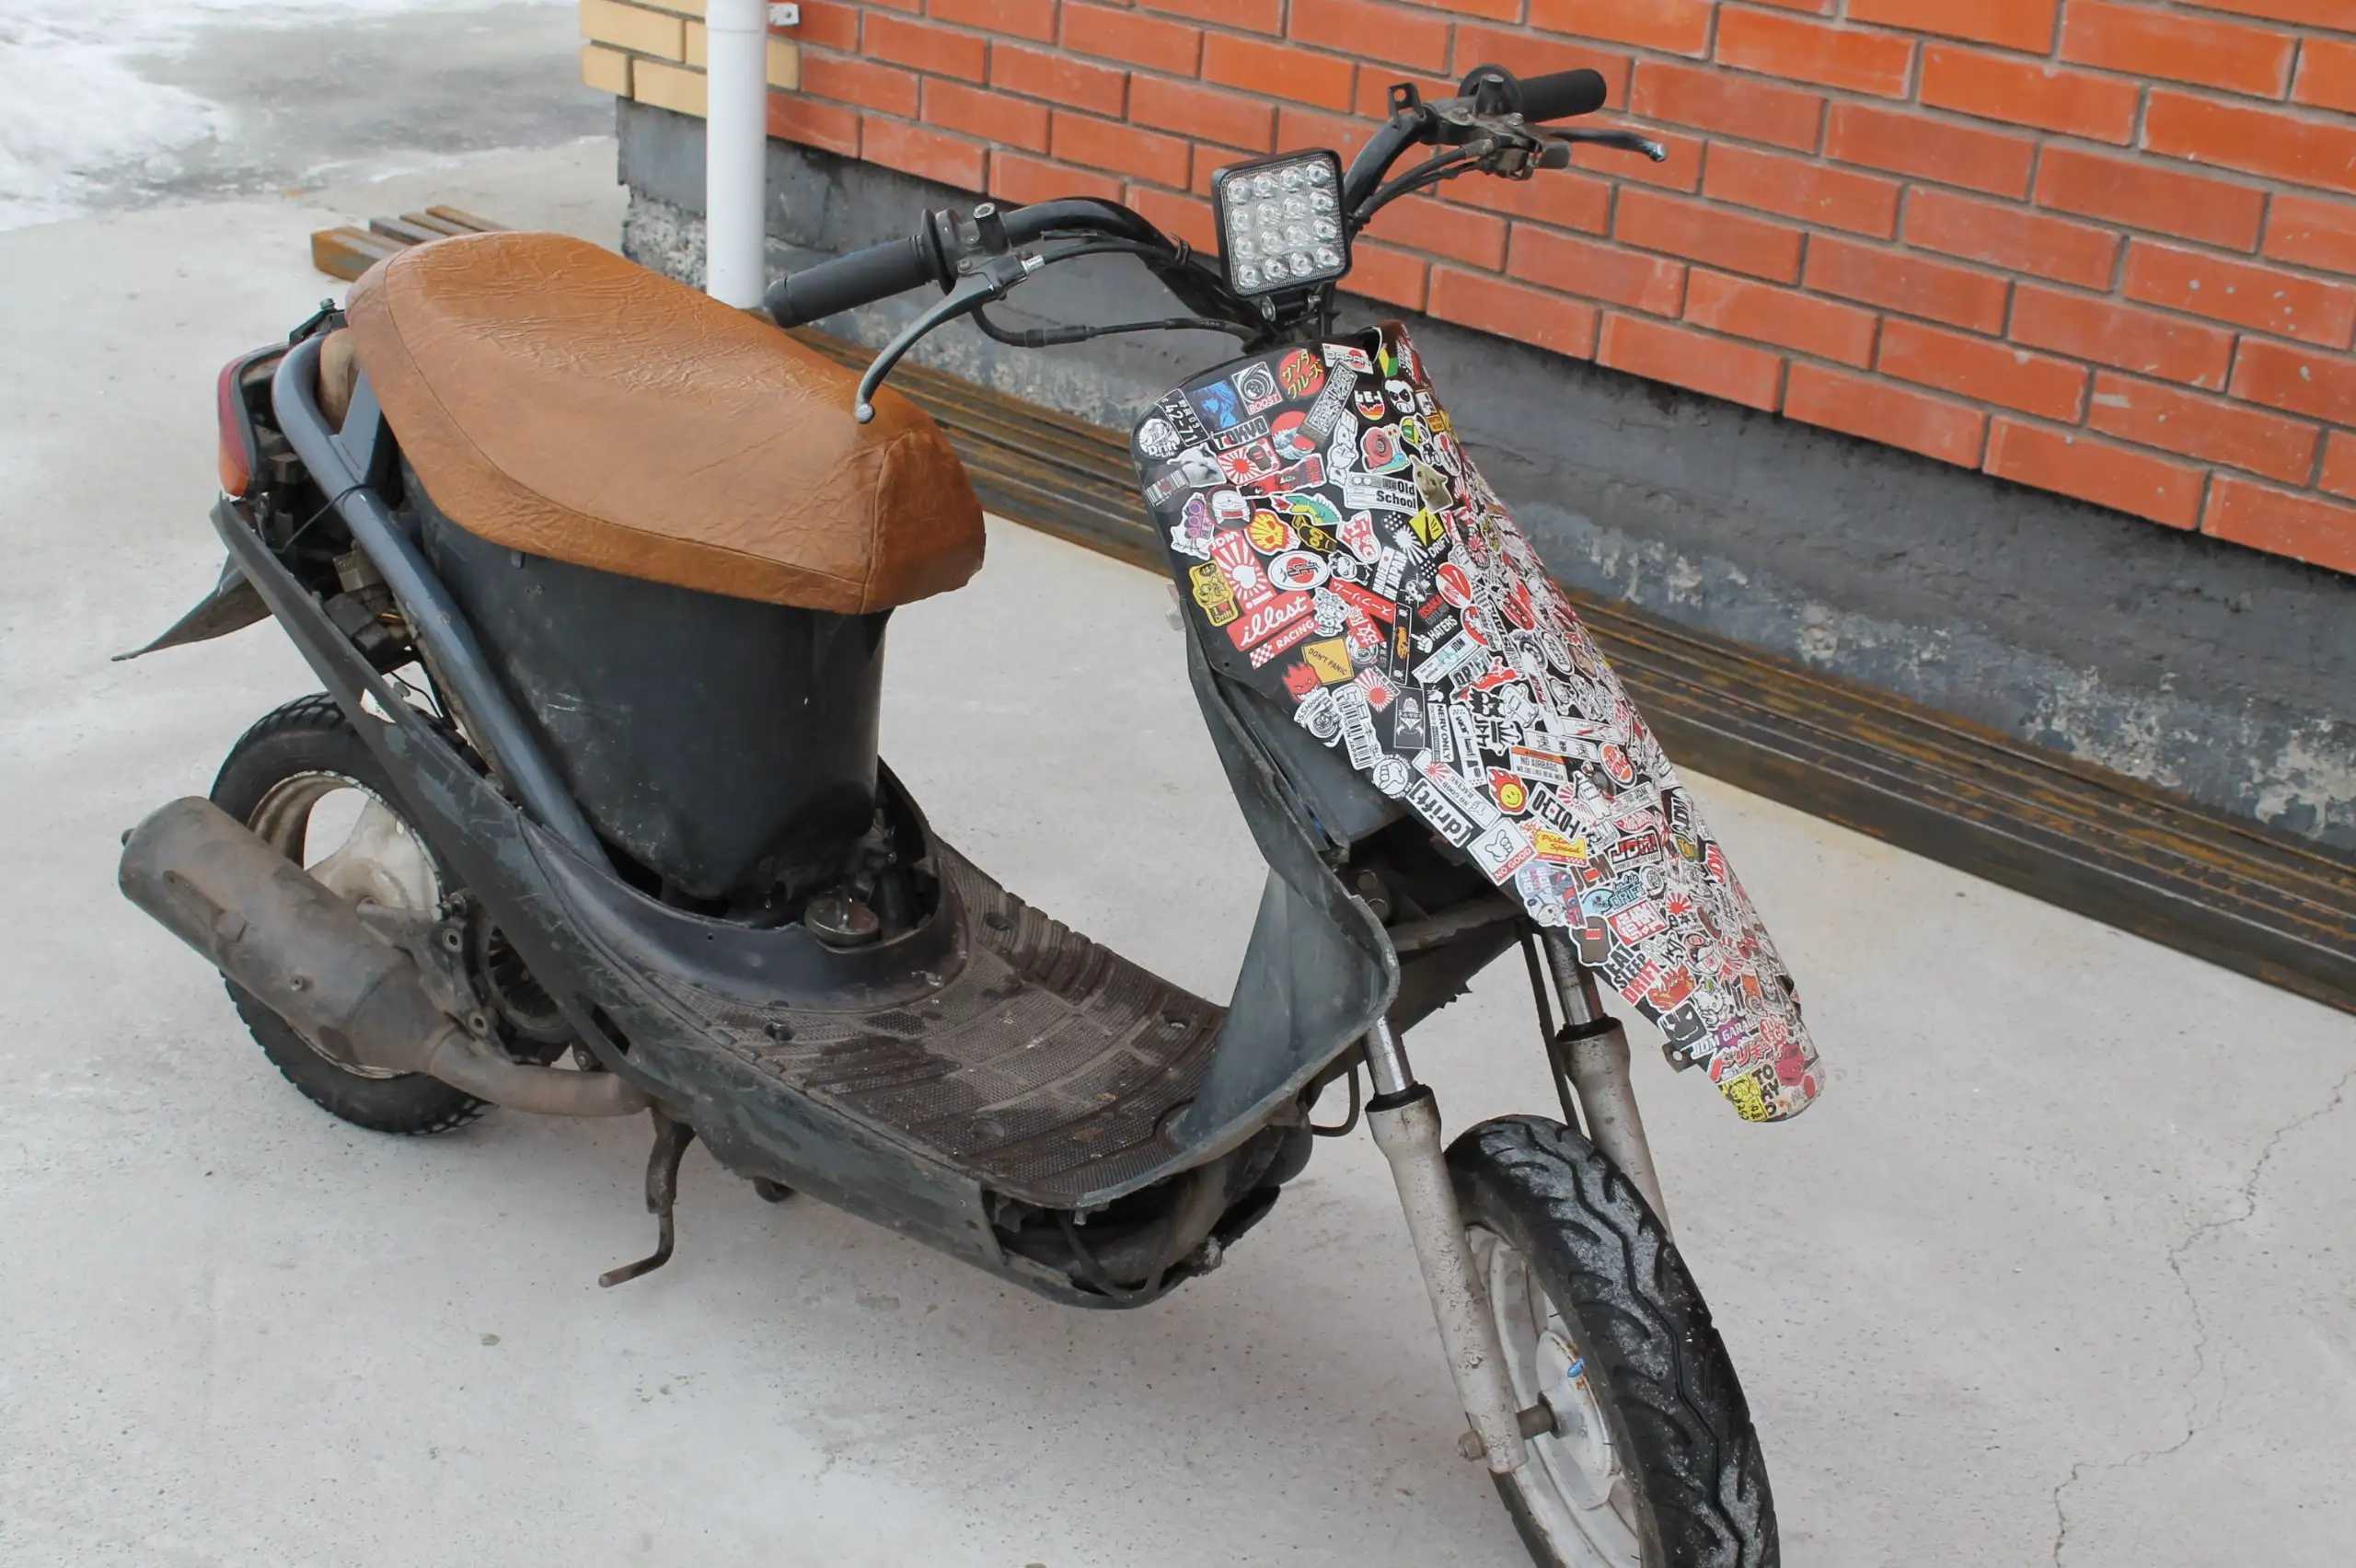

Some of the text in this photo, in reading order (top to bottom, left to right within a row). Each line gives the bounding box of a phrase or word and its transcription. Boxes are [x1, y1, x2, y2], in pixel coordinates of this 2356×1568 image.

[1248, 393, 1280, 413] BOOST
[1164, 404, 1199, 443] 42-71
[1214, 418, 1269, 446] TOKYO
[1147, 442, 1179, 456] Drift
[1376, 490, 1418, 509] School
[1397, 480, 1415, 495] Old
[1208, 531, 1241, 550] JDM
[1428, 535, 1450, 558] DRIFT
[1214, 611, 1233, 622] Drift
[1241, 595, 1307, 647] illest
[1427, 615, 1458, 641] HATERS
[1276, 619, 1315, 650] RACING
[1308, 648, 1348, 675] DON'T PANIC
[1453, 651, 1493, 686] DRIFT
[1437, 705, 1451, 762] NERV ONLY
[1495, 867, 1507, 880] NO
[1507, 847, 1531, 870] GOOD
[1611, 884, 1646, 909] DRIFT
[1605, 943, 1634, 977] EAT
[1614, 953, 1646, 989] SLEEP
[1621, 958, 1661, 1005] DRIFT
[1692, 1038, 1720, 1056] JDM
